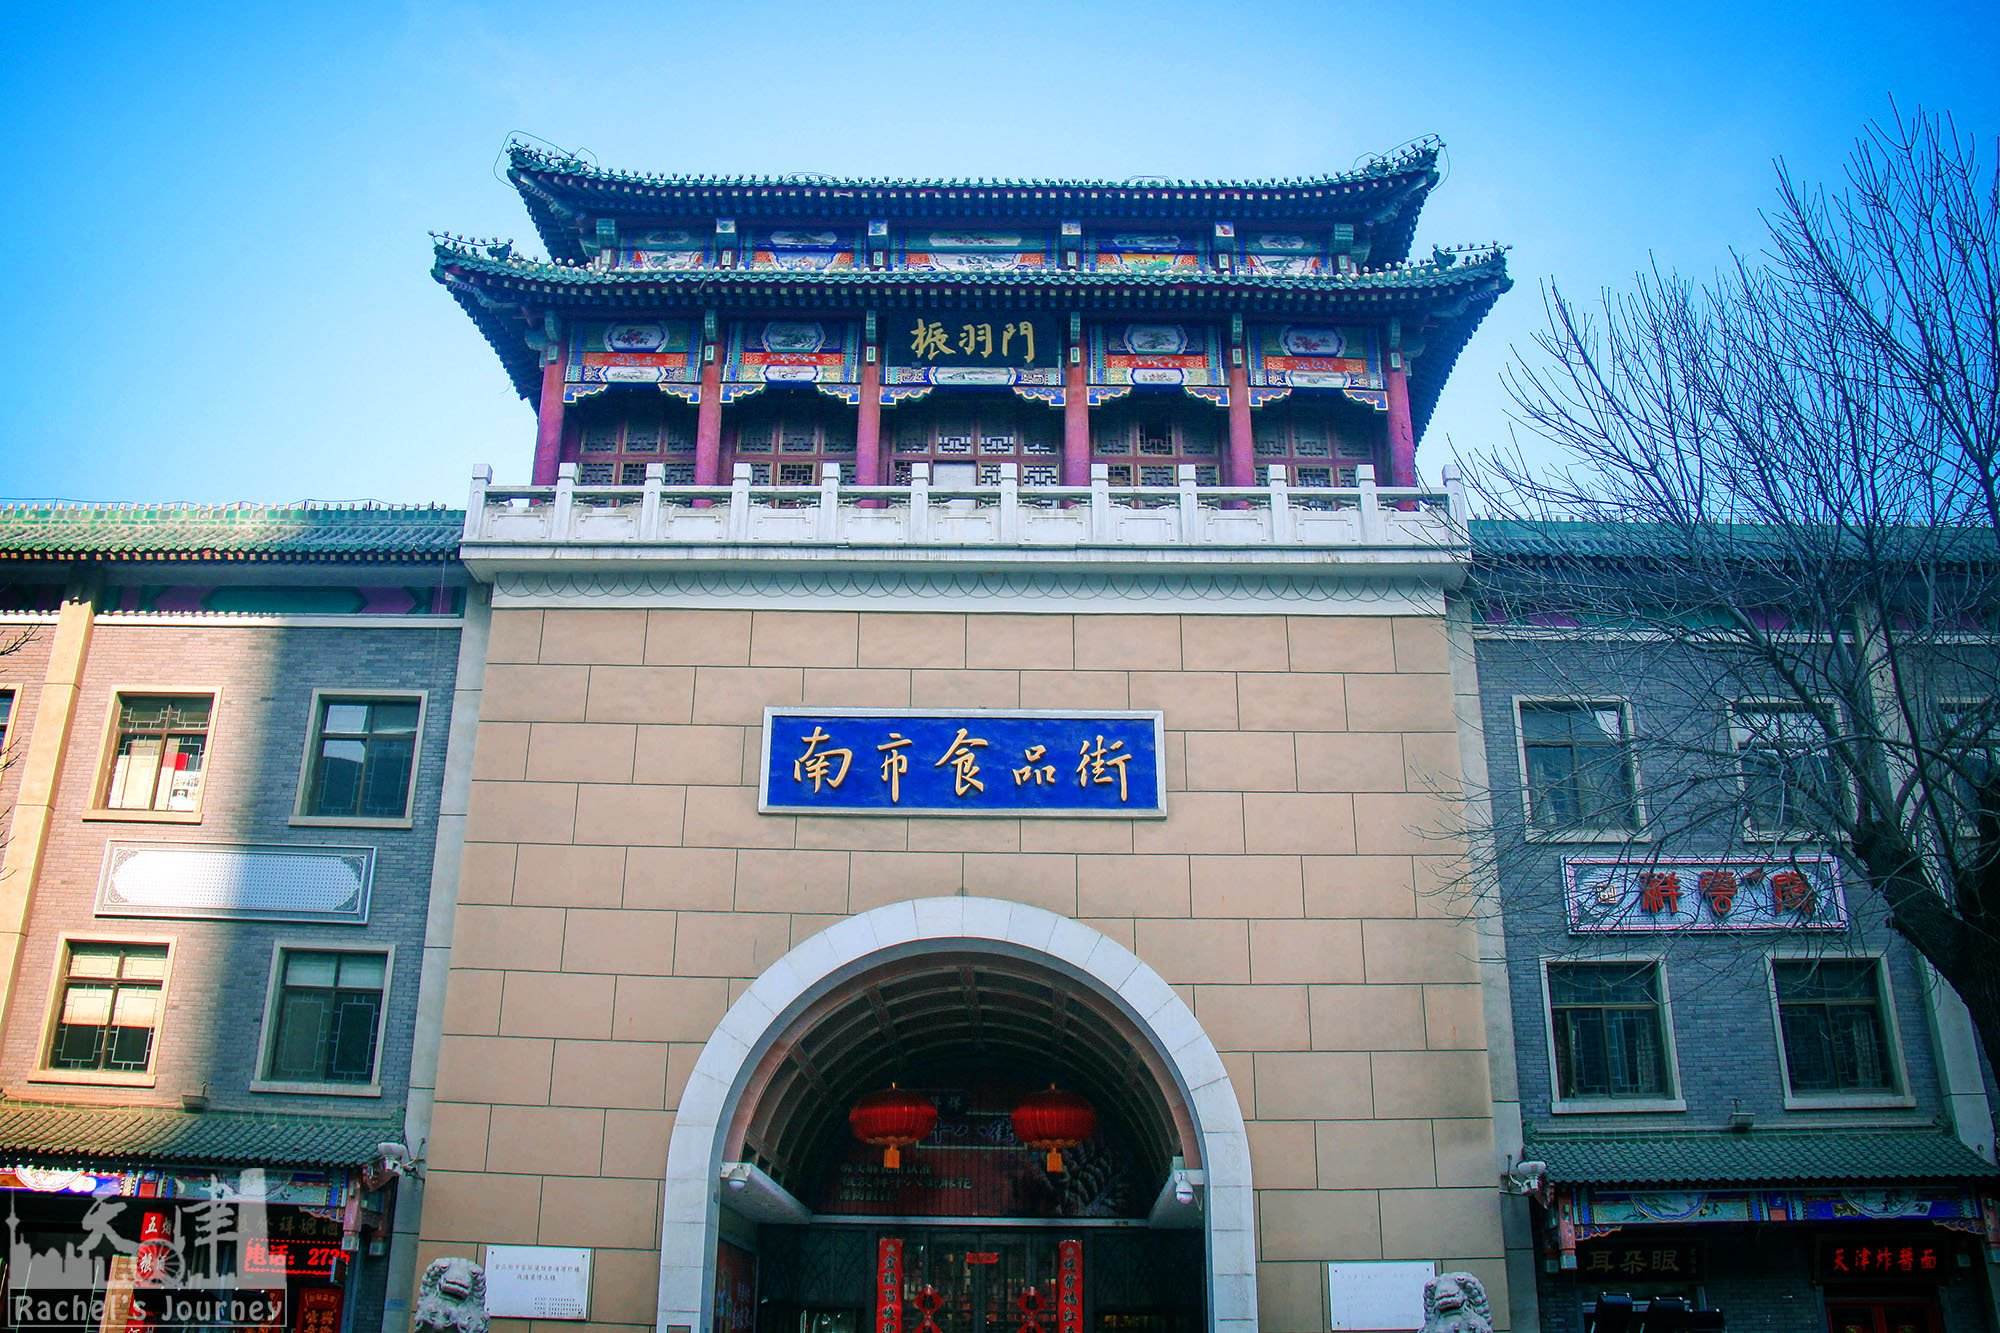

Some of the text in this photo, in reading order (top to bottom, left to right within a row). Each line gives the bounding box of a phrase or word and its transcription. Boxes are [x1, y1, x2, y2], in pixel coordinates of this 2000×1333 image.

[910, 318, 1035, 363] 振羽門
[792, 726, 1132, 803] 南市食品街
[1586, 1248, 1680, 1275] 耳朵眼
